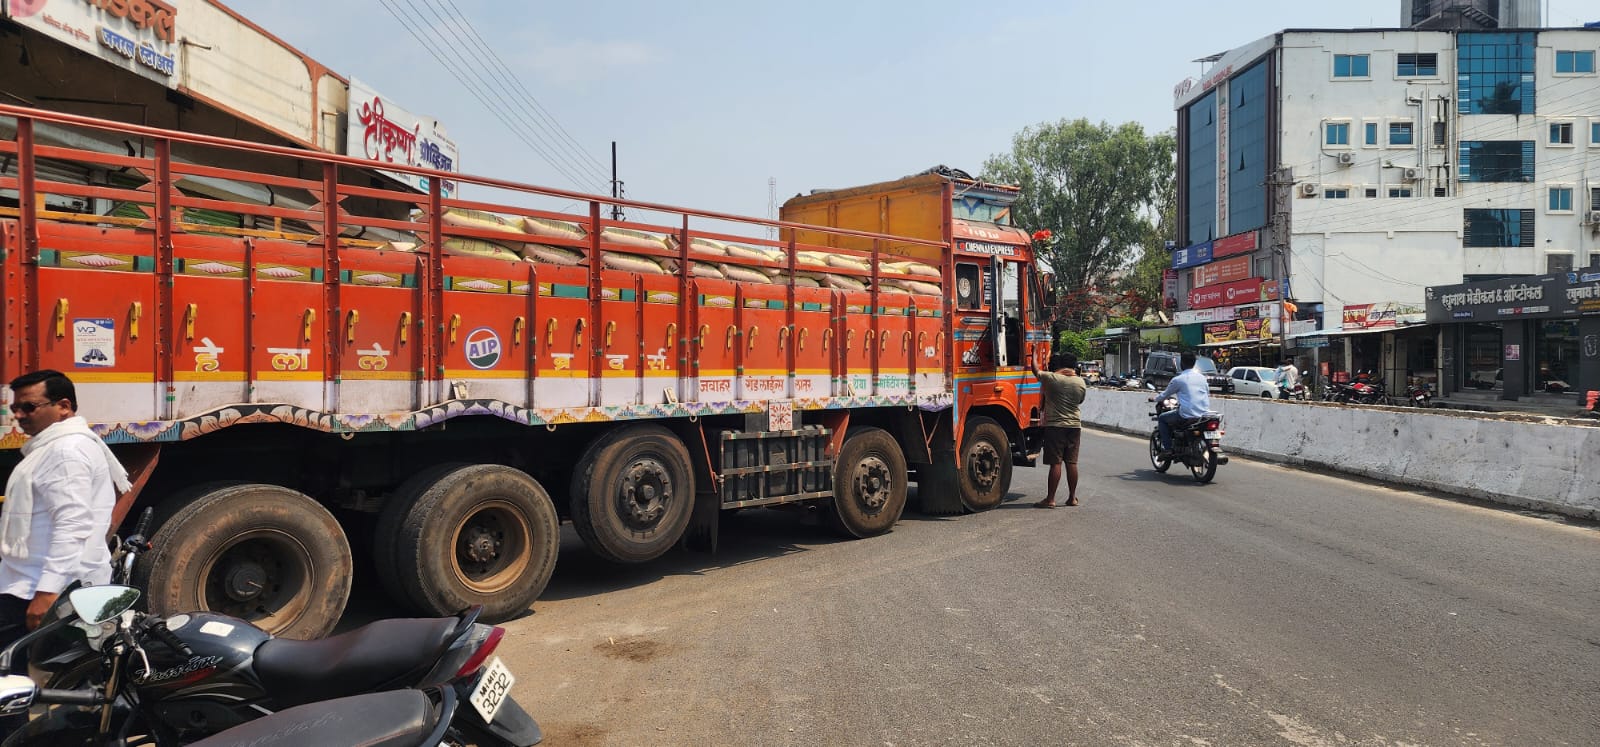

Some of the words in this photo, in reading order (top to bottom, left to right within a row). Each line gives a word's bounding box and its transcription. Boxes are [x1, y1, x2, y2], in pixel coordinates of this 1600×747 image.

[990, 245, 1014, 256] EXPRESS
[1496, 288, 1503, 302] &
[469, 339, 497, 356] AIP
[699, 379, 732, 392] जवाहर
[482, 672, 511, 715] 3232
